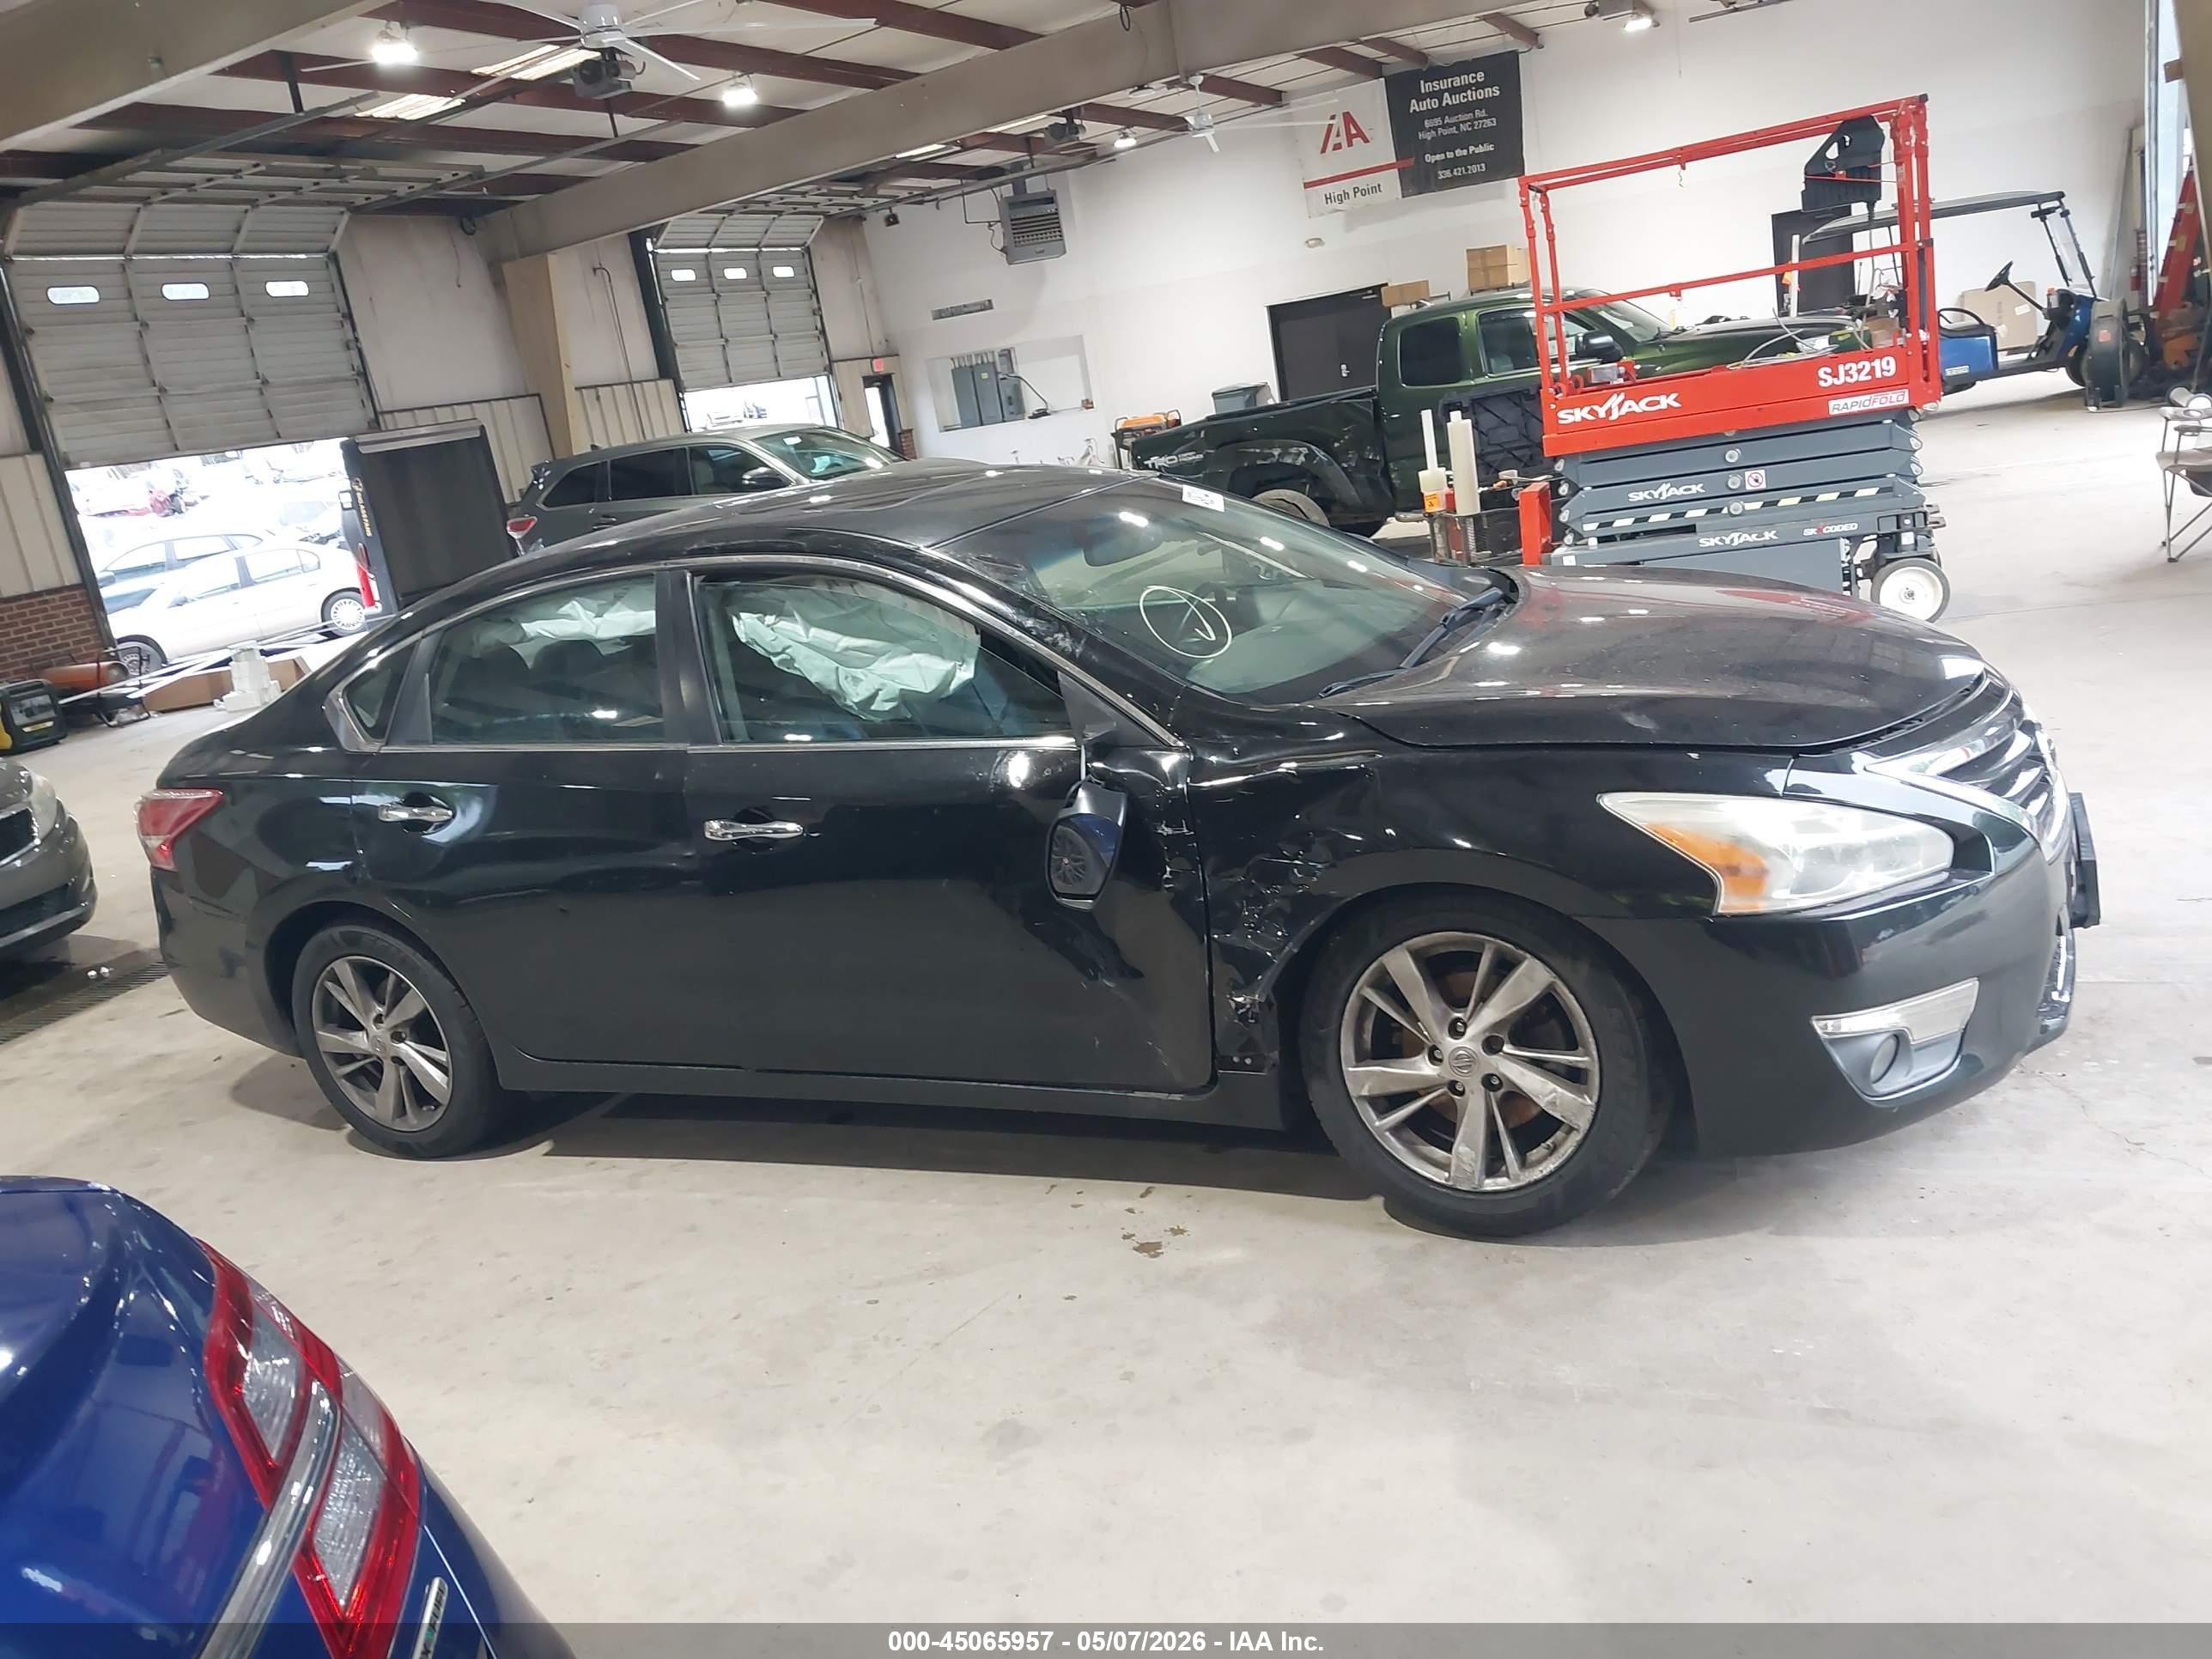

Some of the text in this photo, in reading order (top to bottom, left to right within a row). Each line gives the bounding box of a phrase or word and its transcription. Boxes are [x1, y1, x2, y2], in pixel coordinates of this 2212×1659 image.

[1419, 70, 1485, 94] Insurance
[1409, 84, 1500, 113] Auto Auctions
[1443, 112, 1474, 125] Auction
[1474, 108, 1488, 118] Rd.
[1418, 130, 1437, 141] High
[1460, 122, 1472, 131] NC
[1474, 117, 1497, 130] 27263
[1425, 153, 1445, 163] Open
[1455, 148, 1468, 157] the
[1468, 143, 1495, 155] Public
[1324, 183, 1382, 205] High Point
[1817, 356, 1897, 387] SJ3219
[1557, 392, 1682, 425] SKYJACK
[1627, 483, 1706, 502] SKYJACK
[1698, 529, 1779, 548] SKYJACK
